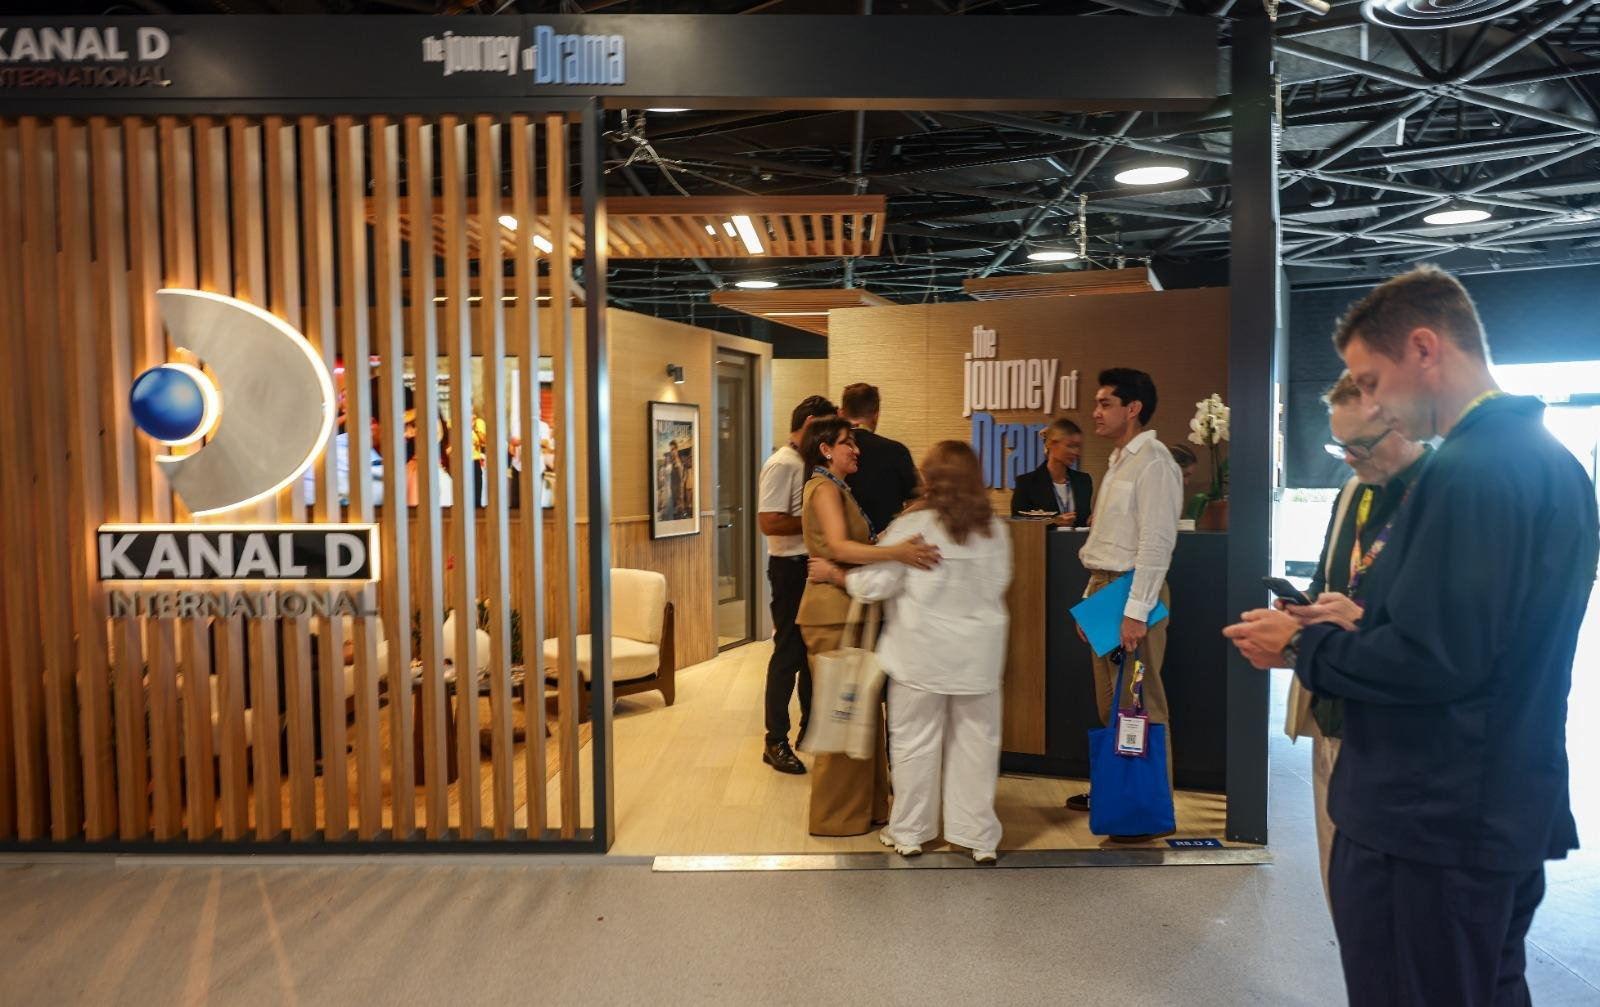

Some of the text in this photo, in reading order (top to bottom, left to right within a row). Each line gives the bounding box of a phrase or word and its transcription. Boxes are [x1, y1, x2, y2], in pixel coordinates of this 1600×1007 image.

[137, 27, 170, 61] D
[422, 36, 445, 62] the
[443, 31, 520, 76] journey
[534, 25, 625, 84] Drama
[972, 324, 997, 359] the
[962, 352, 1079, 418] journey of
[99, 532, 367, 579] KANAL D
[106, 588, 378, 619] INTERNATIONAL
